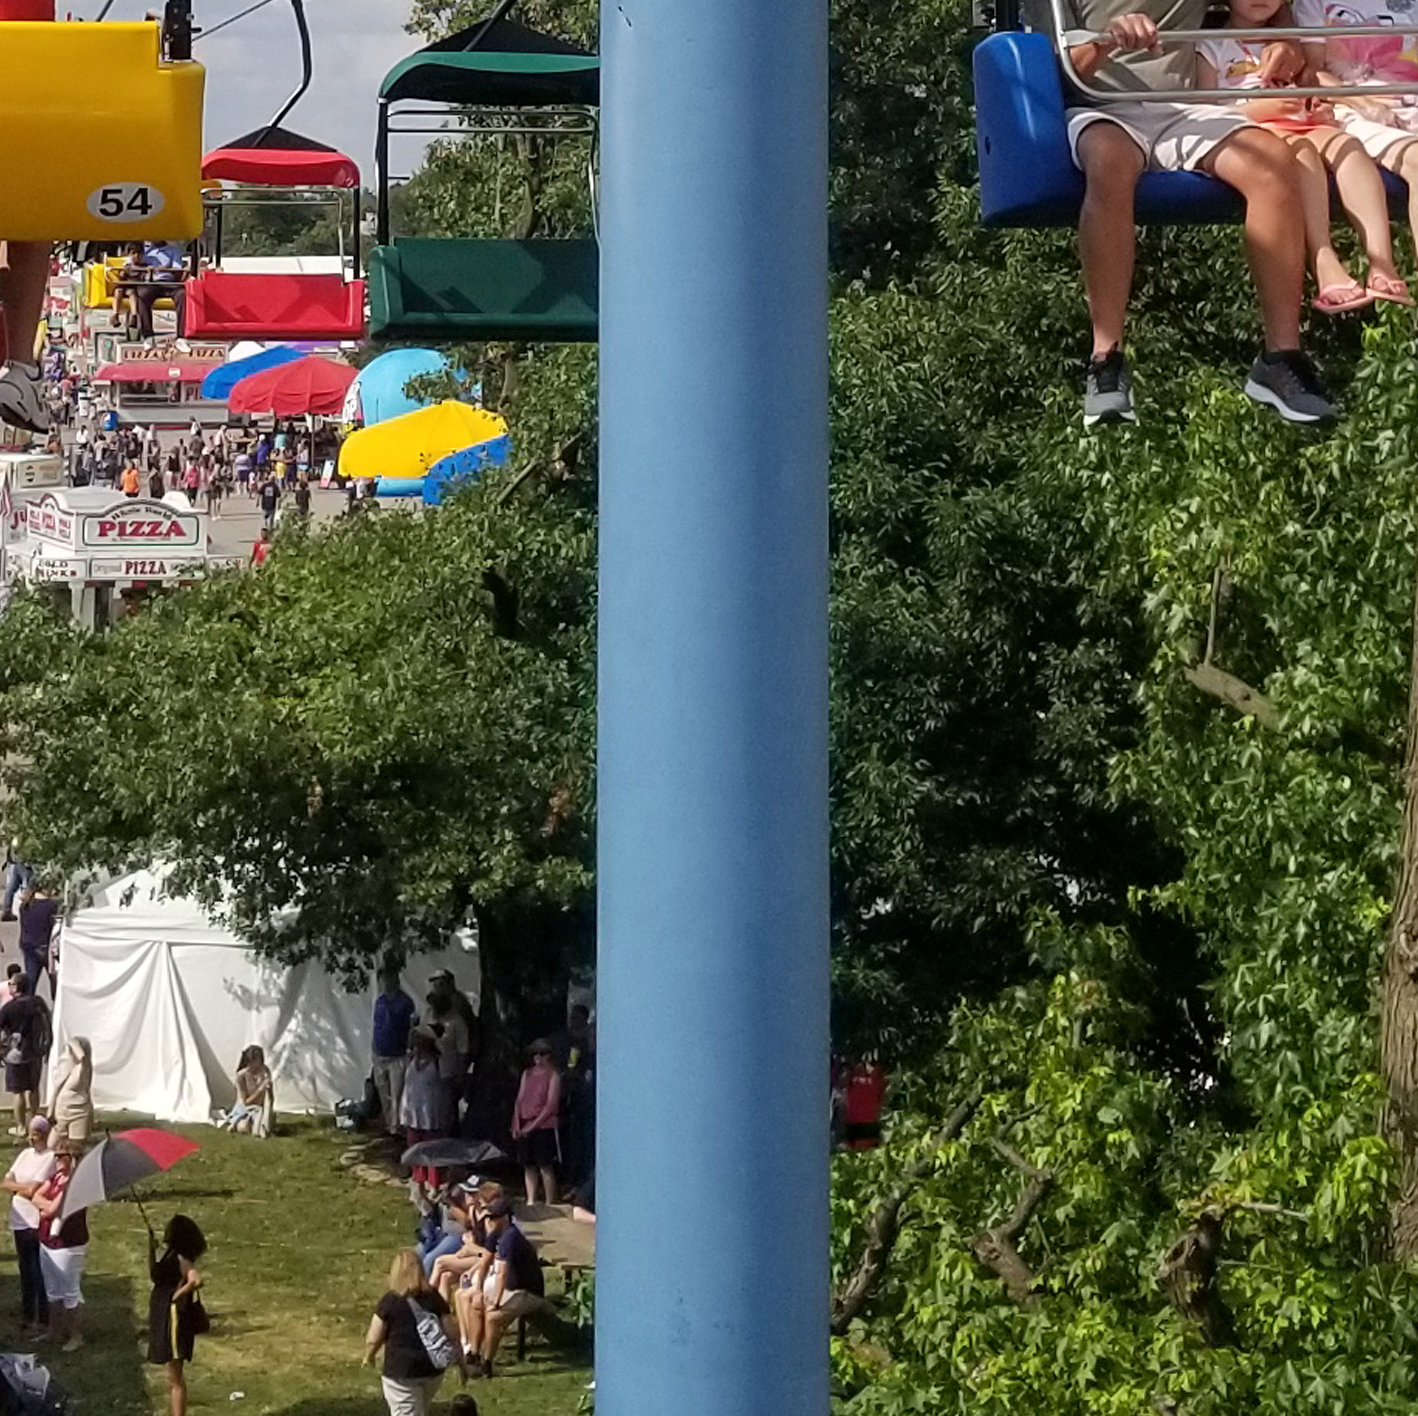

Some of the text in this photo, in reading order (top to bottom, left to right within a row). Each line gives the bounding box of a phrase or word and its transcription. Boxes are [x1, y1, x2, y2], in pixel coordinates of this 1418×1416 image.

[99, 188, 152, 217] 54
[98, 520, 187, 537] PIZZA
[124, 560, 167, 575] PIZZA
